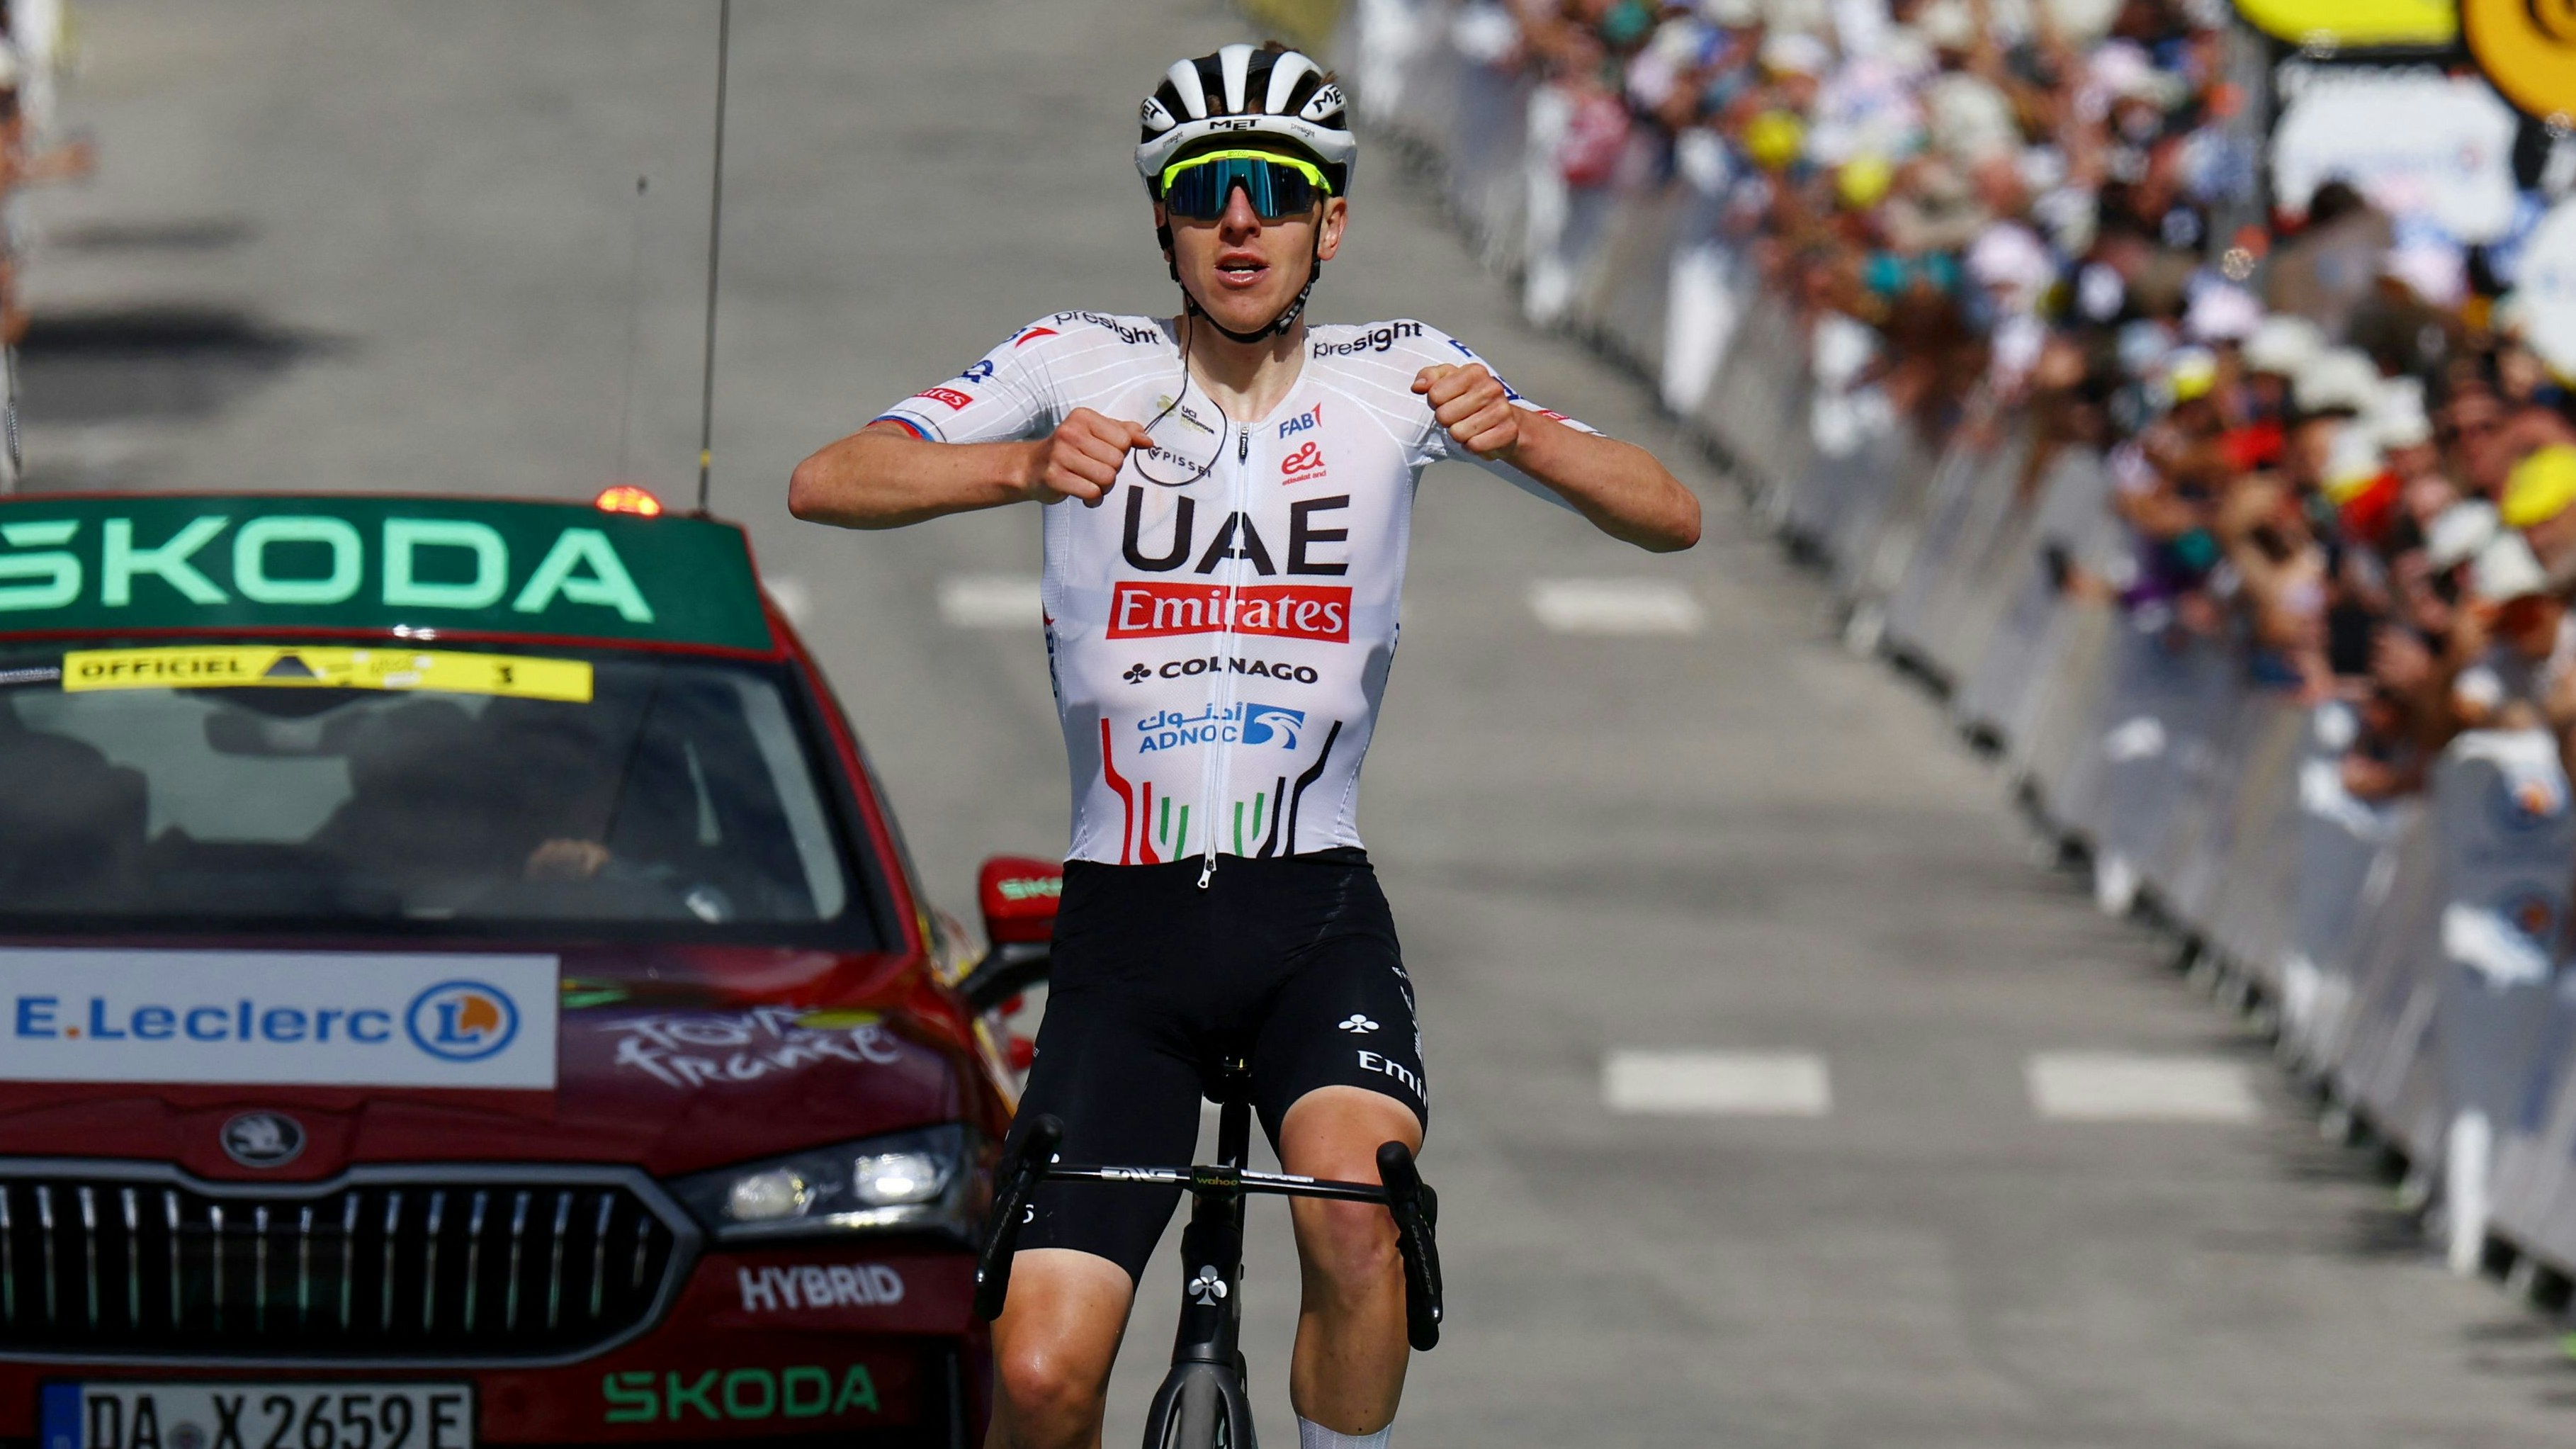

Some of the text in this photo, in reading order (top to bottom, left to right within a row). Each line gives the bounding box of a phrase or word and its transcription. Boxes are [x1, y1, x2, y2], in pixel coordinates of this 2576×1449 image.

[1141, 99, 1163, 121] ET
[1209, 119, 1261, 131] MET
[1054, 310, 1160, 346] presight
[1314, 321, 1423, 359] presight
[1181, 405, 1197, 419] UCI
[1122, 485, 1350, 576] UAE
[1118, 589, 1343, 633] Emirates
[79, 658, 247, 681] OFFICIEL
[1159, 656, 1318, 684] COLNAGO
[1139, 724, 1238, 754] ADNOC
[14, 996, 393, 1044] E.Leclerc
[1197, 1175, 1238, 1187] wahoo
[737, 1263, 905, 1312] HYBRID
[86, 1394, 160, 1449] DA
